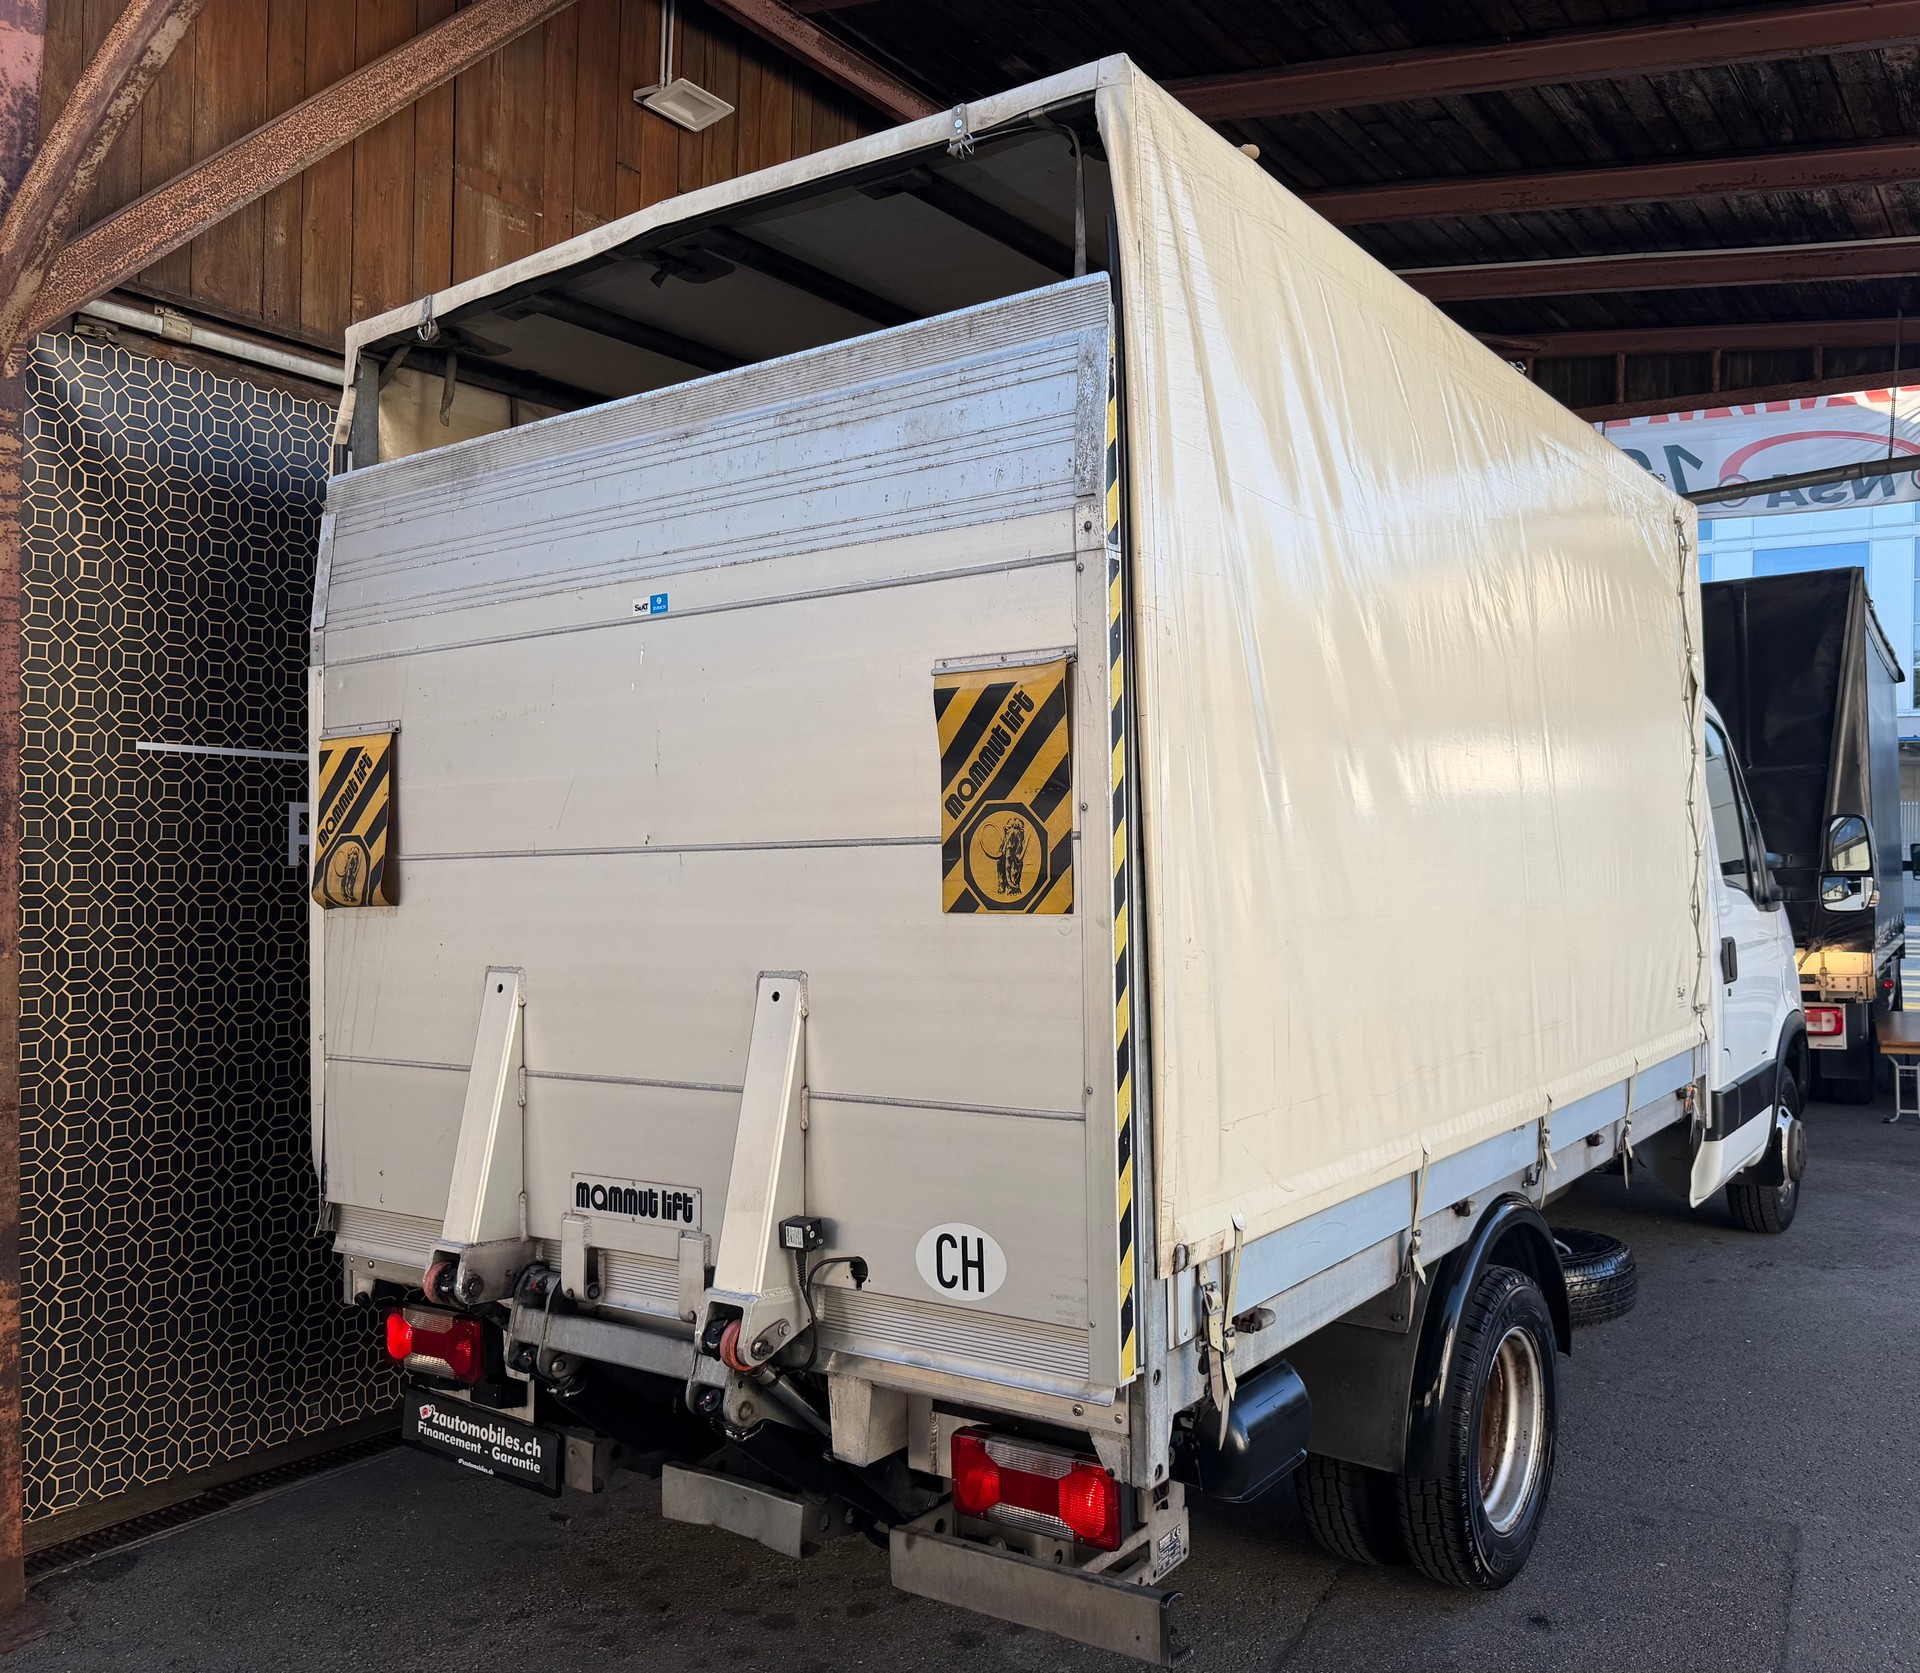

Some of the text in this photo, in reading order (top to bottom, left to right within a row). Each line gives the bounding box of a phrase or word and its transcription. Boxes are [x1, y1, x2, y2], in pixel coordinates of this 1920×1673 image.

[999, 690, 1035, 734] lift
[354, 753, 373, 785] lift
[576, 1181, 693, 1224] mammut lift
[936, 1233, 985, 1293] CH
[418, 1421, 482, 1455] Financement
[491, 1446, 541, 1474] Garantie
